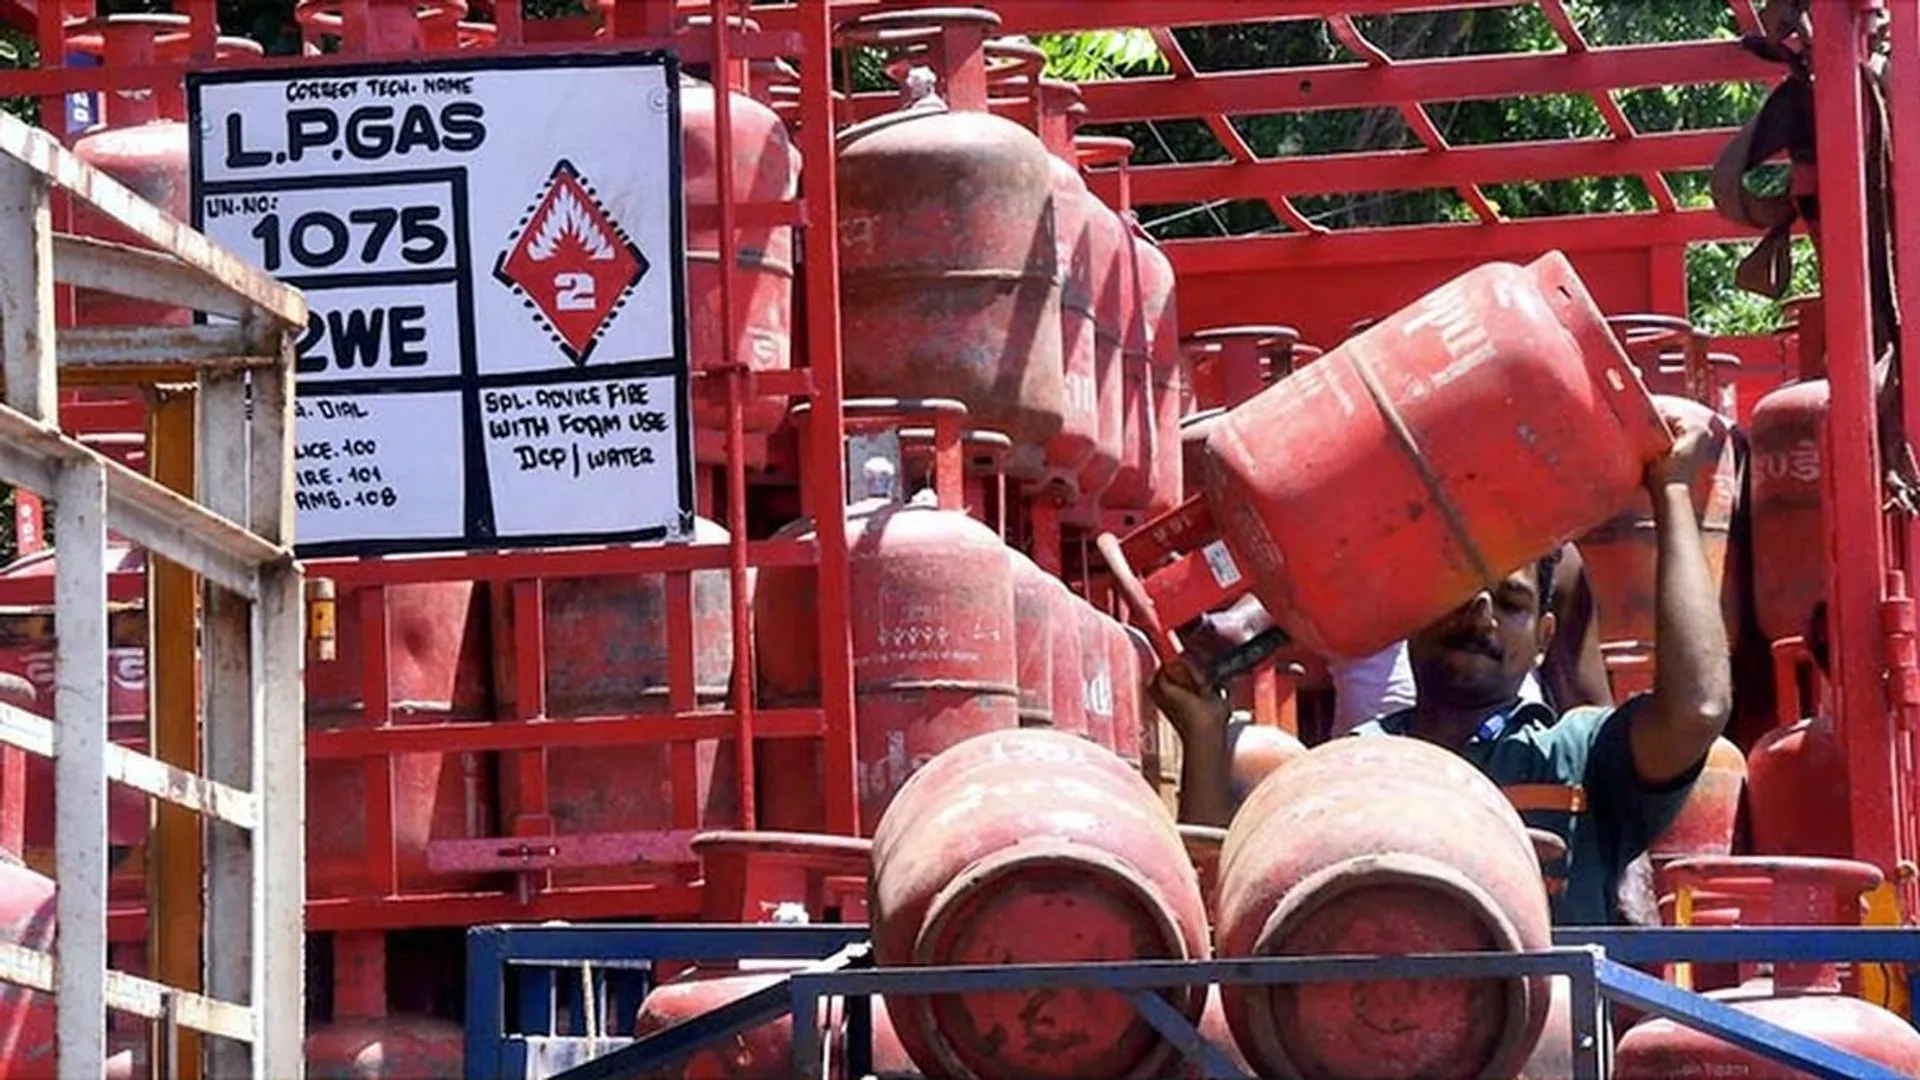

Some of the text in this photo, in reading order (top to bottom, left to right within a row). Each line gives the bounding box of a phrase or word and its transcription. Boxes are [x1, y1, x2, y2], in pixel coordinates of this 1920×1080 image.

[285, 80, 358, 102] CORRECT
[423, 77, 474, 95] NAME
[225, 101, 486, 170] L.P.GAS
[251, 206, 449, 271] 1075
[553, 272, 596, 310] 2
[316, 400, 369, 419] DIAL
[535, 386, 601, 409] ADVICE
[489, 411, 670, 439] WITH FOAM USE
[586, 446, 656, 471] WATER
